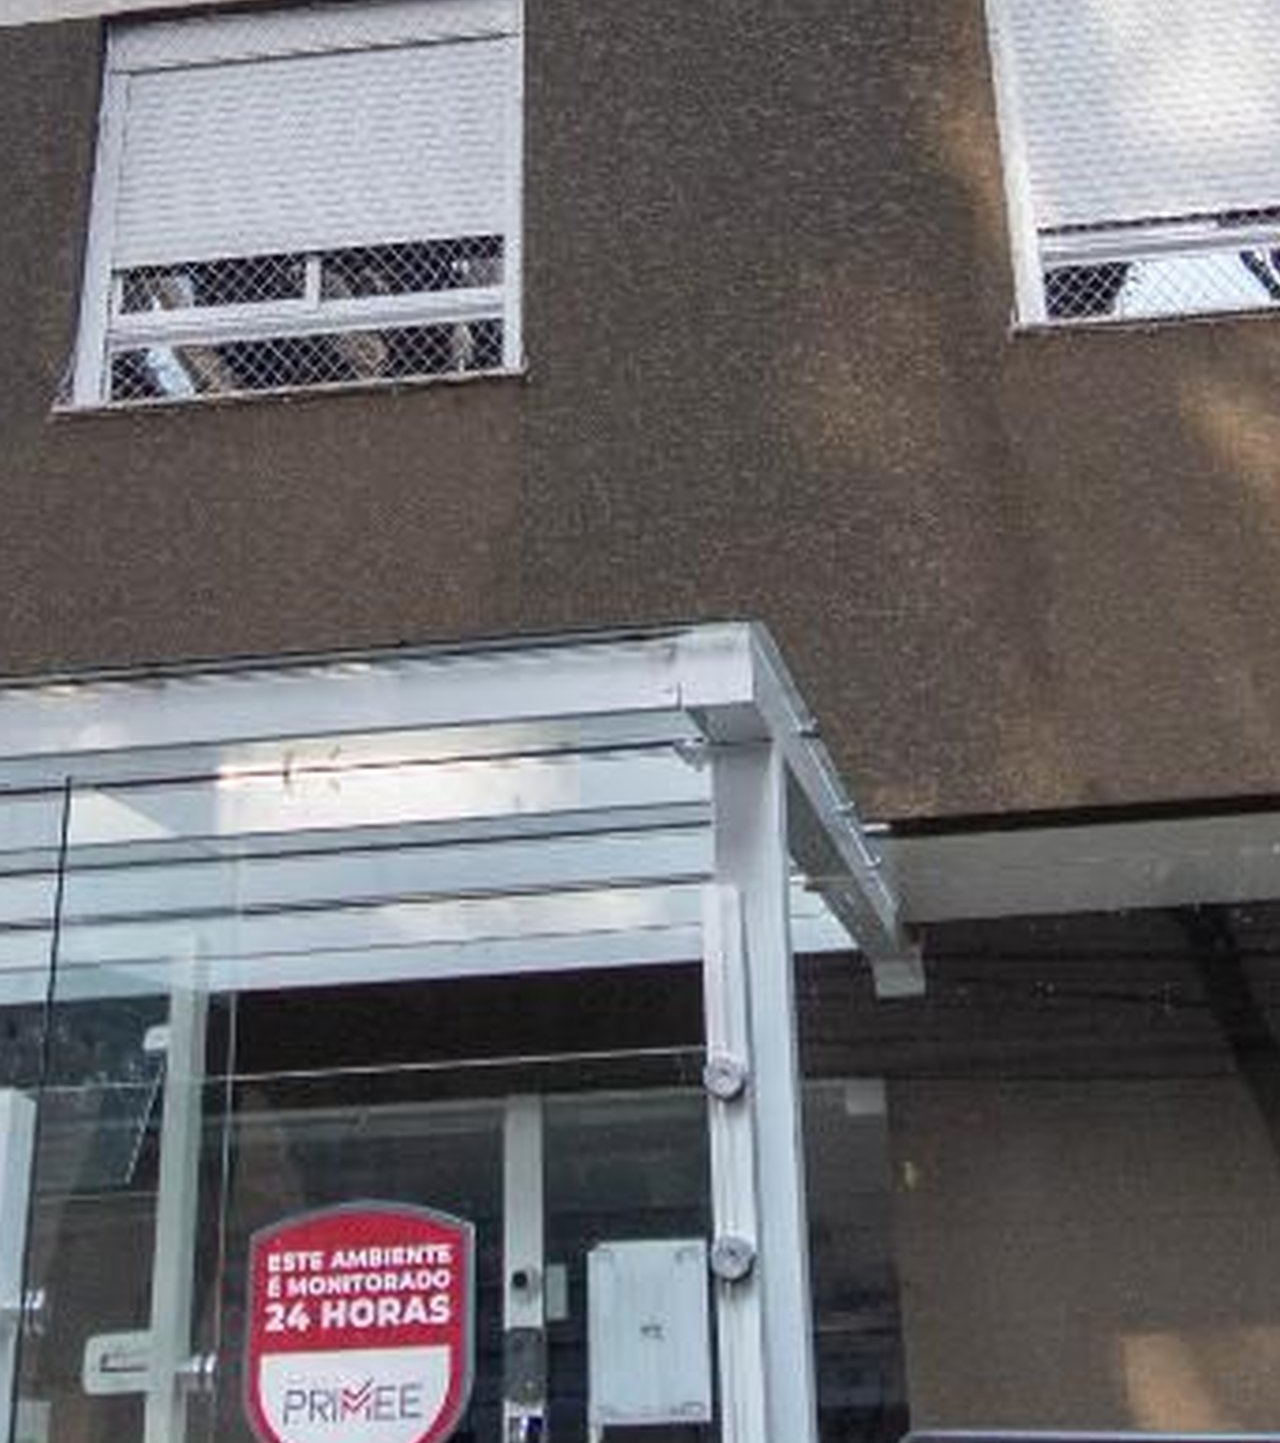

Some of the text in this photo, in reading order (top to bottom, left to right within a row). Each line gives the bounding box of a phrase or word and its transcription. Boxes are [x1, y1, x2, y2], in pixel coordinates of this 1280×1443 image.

[267, 1244, 453, 1272] ESTE AMBIENTE
[267, 1270, 451, 1298] É MONITORADO
[265, 1294, 451, 1332] 24 HORAS
[283, 1377, 423, 1425] PRIMEE
